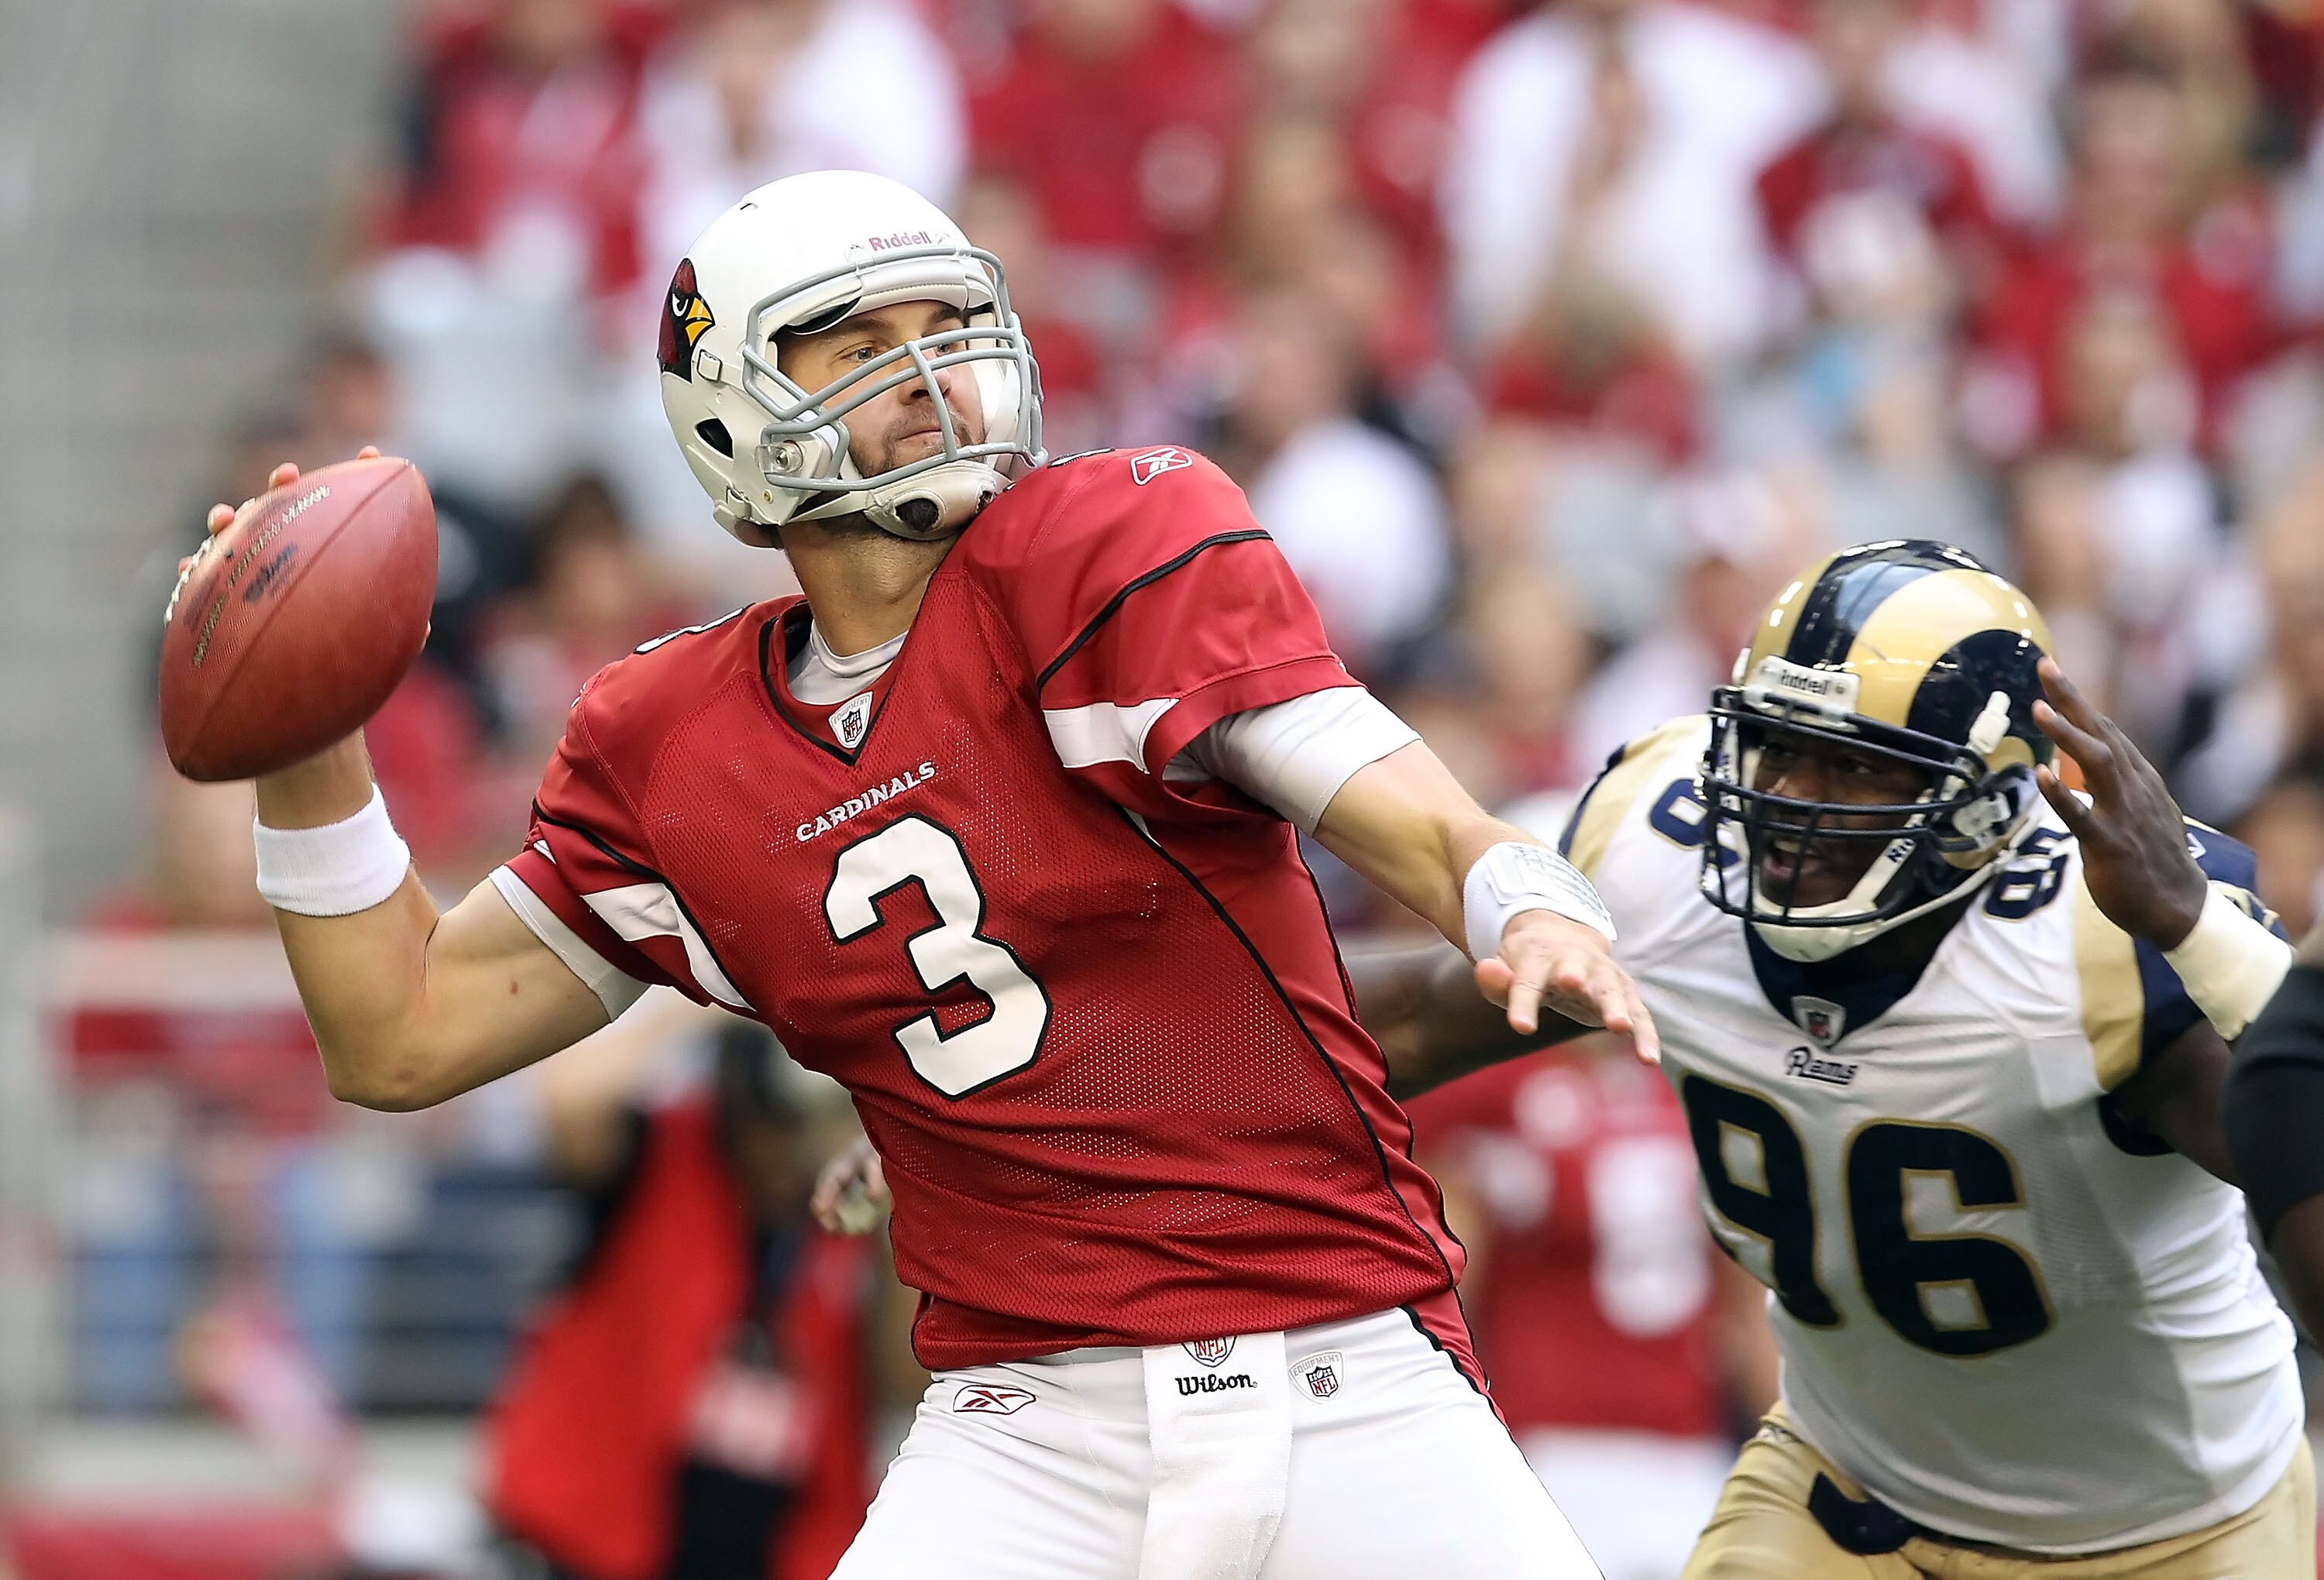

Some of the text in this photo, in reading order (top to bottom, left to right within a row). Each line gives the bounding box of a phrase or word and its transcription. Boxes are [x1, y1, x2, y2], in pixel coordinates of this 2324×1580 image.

[868, 231, 932, 252] Riddell
[844, 720, 861, 740] NFL
[795, 761, 937, 843] CARDINALS
[821, 811, 1054, 1101] 3
[1679, 1071, 2058, 1360] 96
[1198, 1338, 1224, 1357] NFL
[1292, 1354, 1340, 1377] EQUIPMENT
[1174, 1374, 1254, 1396] Wilson
[1312, 1377, 1336, 1394] NFL
